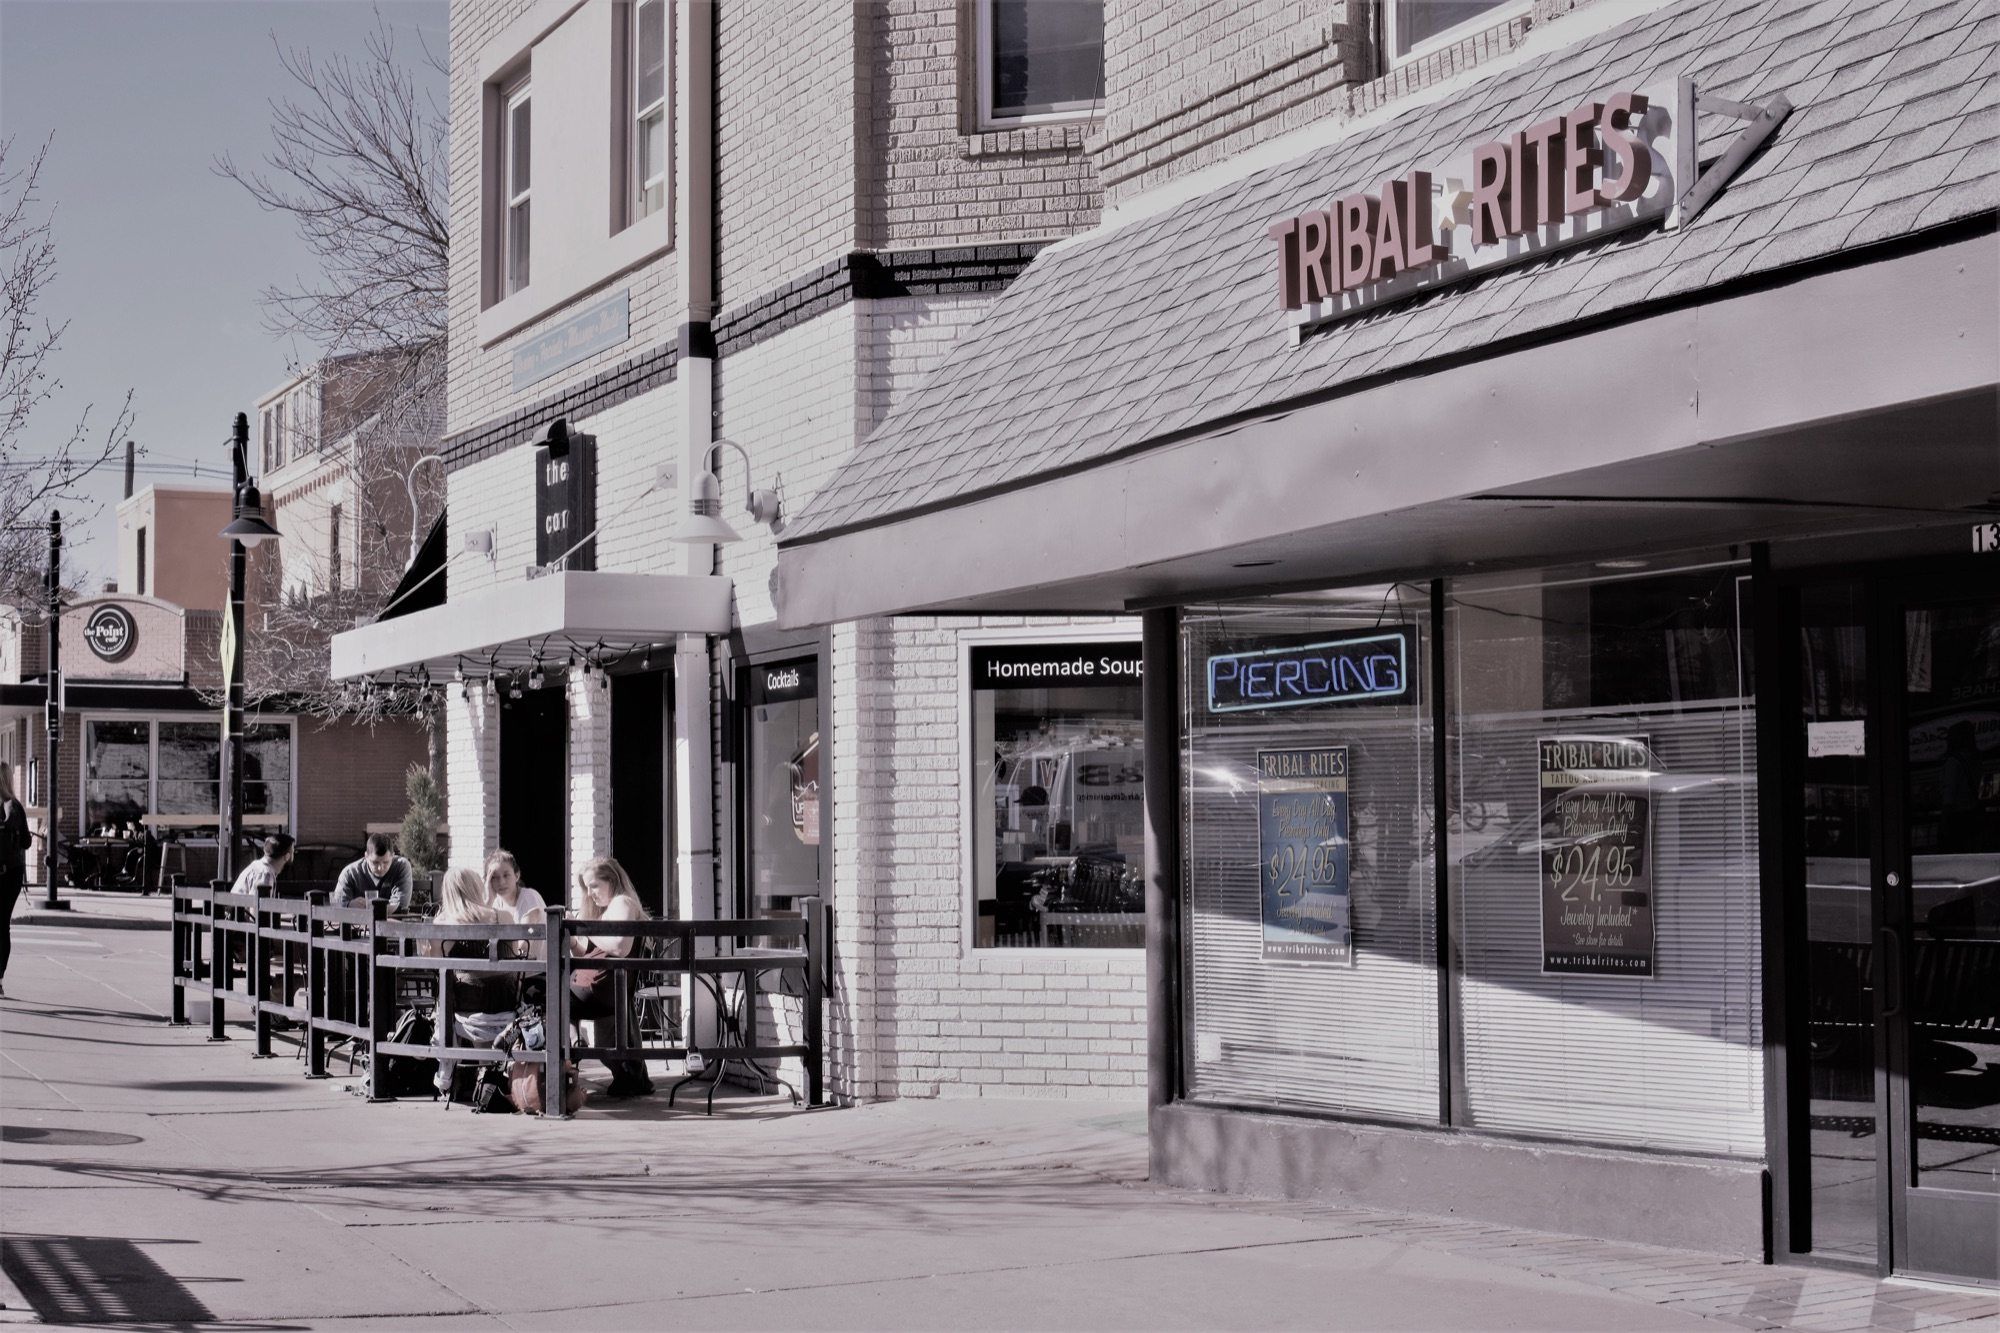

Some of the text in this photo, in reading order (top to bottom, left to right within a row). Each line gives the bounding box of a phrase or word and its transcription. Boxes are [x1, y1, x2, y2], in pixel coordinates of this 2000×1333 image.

[1268, 92, 1652, 311] TRIBAL RITES
[546, 461, 569, 487] the
[1974, 522, 2000, 550] 13
[96, 625, 124, 637] Point
[767, 669, 799, 691] Cocktails
[987, 656, 1144, 678] Homemade Soup
[1211, 655, 1398, 699] PIERCING
[1262, 752, 1345, 777] TRIBAL RITES
[1544, 743, 1646, 769] TRIBAL RITES
[1551, 773, 1579, 784] TATTOO
[1555, 792, 1636, 820] Every Day All Day
[1563, 815, 1629, 843] Piercings Only
[1550, 845, 1636, 902] $24.95
[1560, 905, 1595, 933] Jewelry
[1550, 955, 1646, 967] www.tribalrites.com
